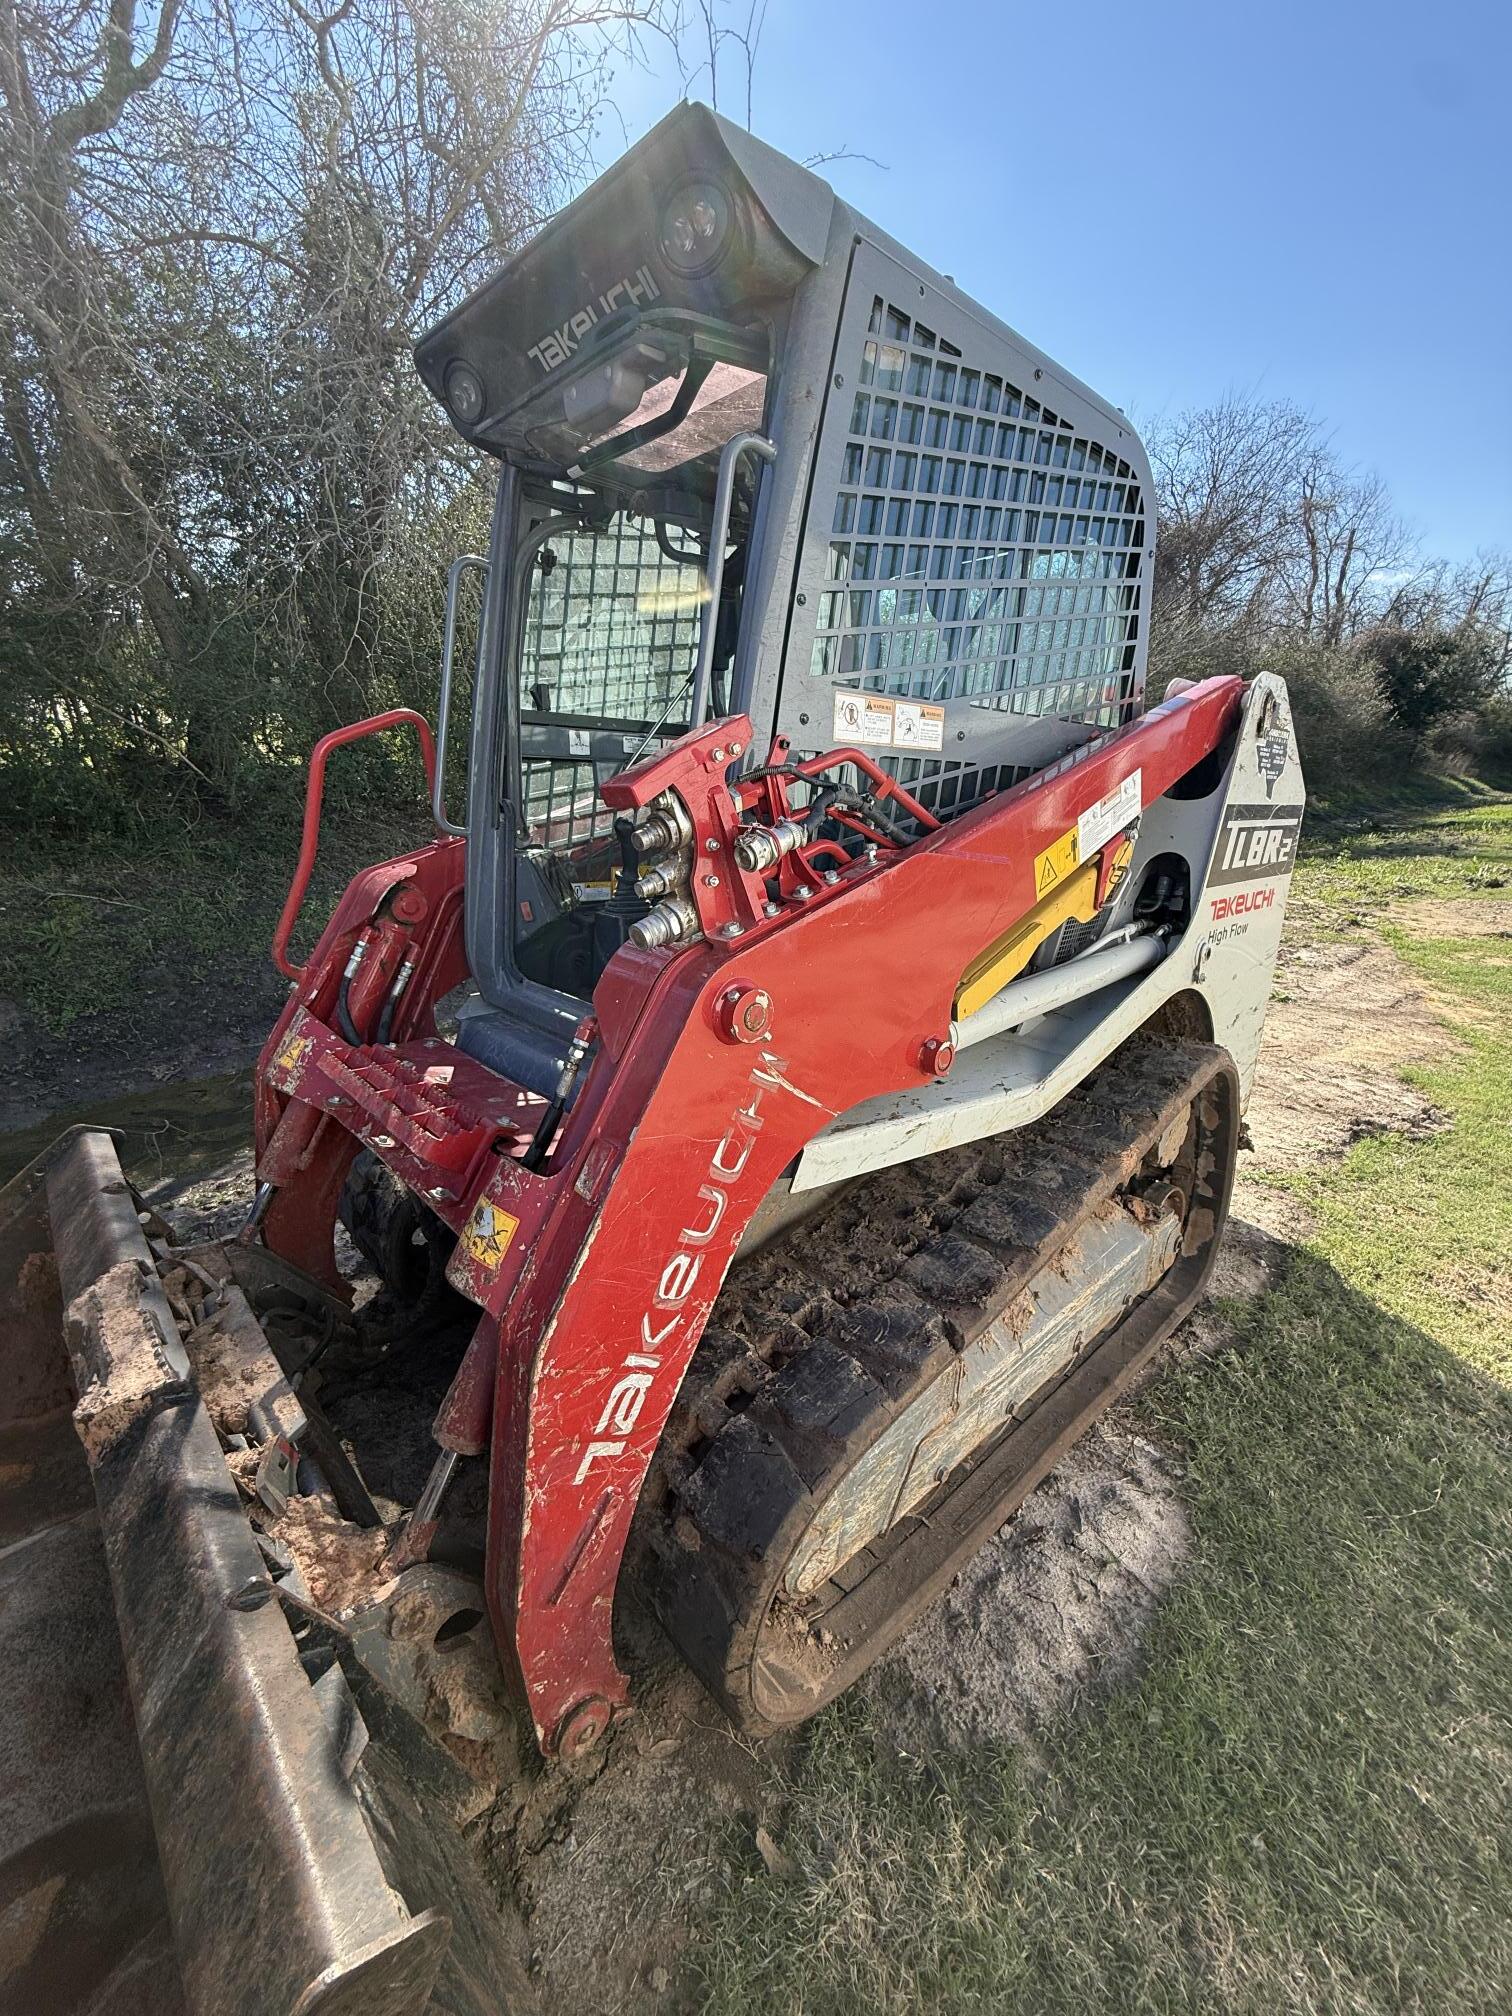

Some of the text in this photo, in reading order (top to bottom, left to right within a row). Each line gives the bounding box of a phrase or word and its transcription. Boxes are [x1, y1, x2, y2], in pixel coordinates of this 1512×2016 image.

[1210, 888, 1276, 922] TAKEUCHI
[1207, 922, 1249, 946] High Flow
